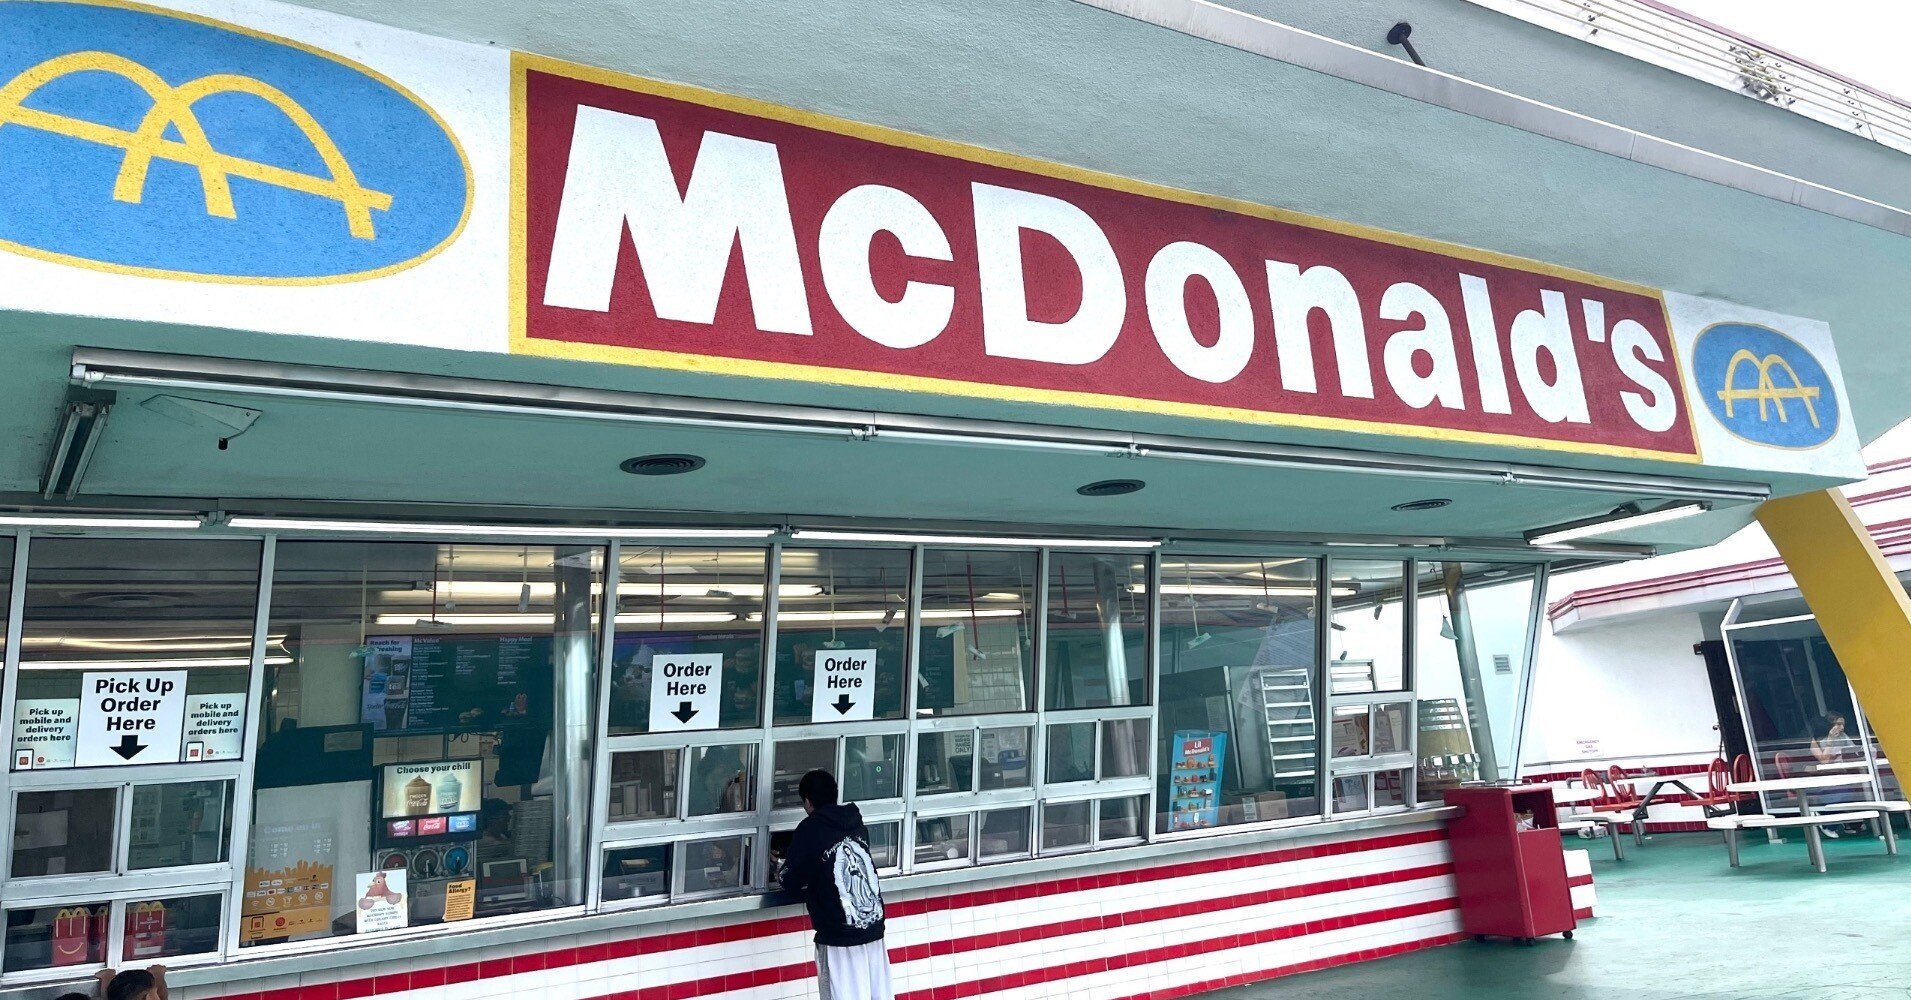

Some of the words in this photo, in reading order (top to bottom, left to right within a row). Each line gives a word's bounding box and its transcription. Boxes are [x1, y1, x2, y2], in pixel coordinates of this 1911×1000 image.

[543, 104, 1676, 432] McDonald's
[663, 662, 712, 678] Order
[824, 657, 867, 671] Order
[96, 678, 140, 694] Pick
[146, 678, 174, 696] Up
[827, 675, 862, 688] Here
[666, 681, 707, 696] Here
[101, 697, 161, 712] Order
[51, 709, 64, 717] up
[19, 716, 52, 724] mobile
[54, 716, 71, 724] and
[106, 717, 156, 731] Here
[196, 719, 231, 728] delivery
[26, 725, 64, 735] delivery
[188, 727, 220, 735] orders
[17, 734, 48, 742] orders
[50, 734, 71, 742] here
[431, 765, 450, 773] your
[452, 762, 470, 770] chill
